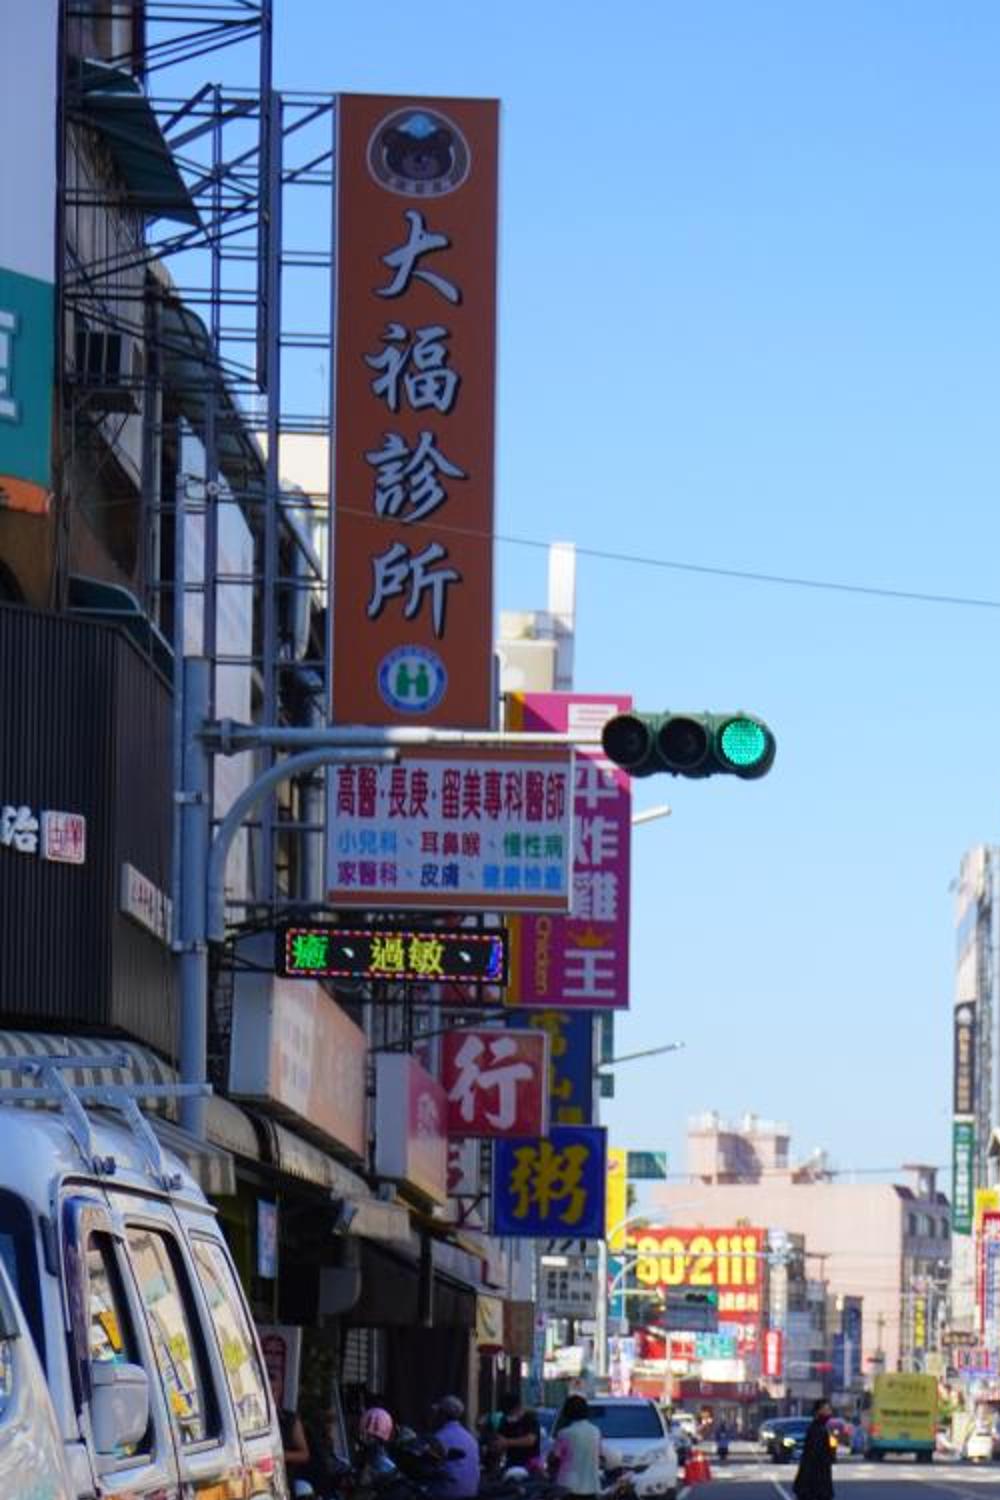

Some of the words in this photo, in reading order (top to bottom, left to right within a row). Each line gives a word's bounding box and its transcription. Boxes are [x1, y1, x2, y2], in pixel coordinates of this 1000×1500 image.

[364, 208, 466, 640] 大福診所
[448, 1034, 534, 1131] 行
[510, 1142, 590, 1224] 粥
